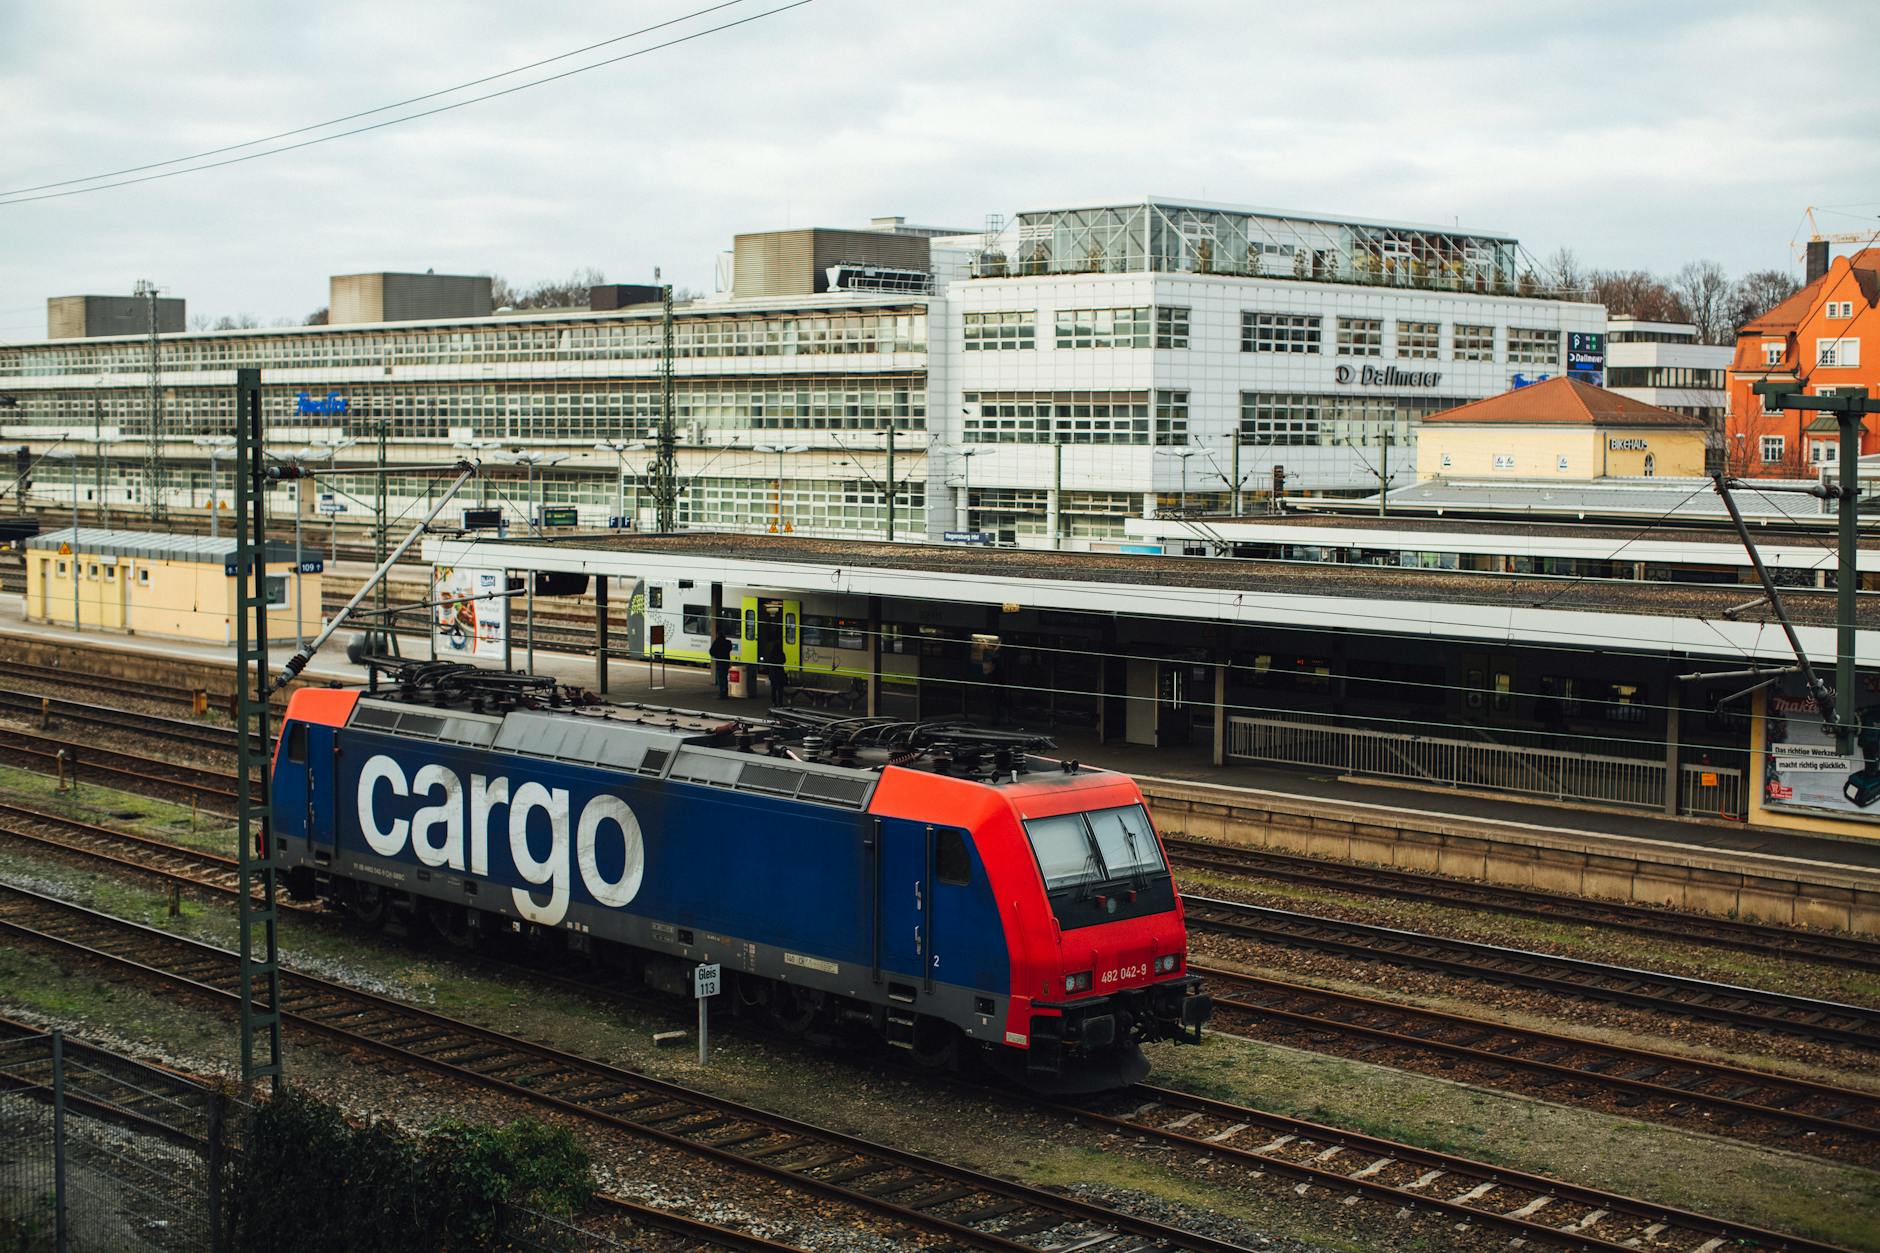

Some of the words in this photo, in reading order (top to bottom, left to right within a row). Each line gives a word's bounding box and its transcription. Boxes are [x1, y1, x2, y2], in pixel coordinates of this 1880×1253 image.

[1575, 353, 1603, 363] Dallmeier
[1361, 365, 1442, 387] Dallmeier
[1610, 439, 1648, 450] BIKEHAUS
[302, 563, 315, 573] 109
[1787, 748, 1810, 756] richtige
[1779, 761, 1798, 769] macht
[1799, 761, 1818, 770] richtig
[1819, 762, 1847, 770] glücklich.
[357, 755, 645, 926] cargo
[933, 955, 940, 967] 2
[698, 967, 717, 980] Gleis
[1101, 970, 1118, 984] 482
[1120, 963, 1147, 980] 042-9
[700, 982, 715, 996] 113
